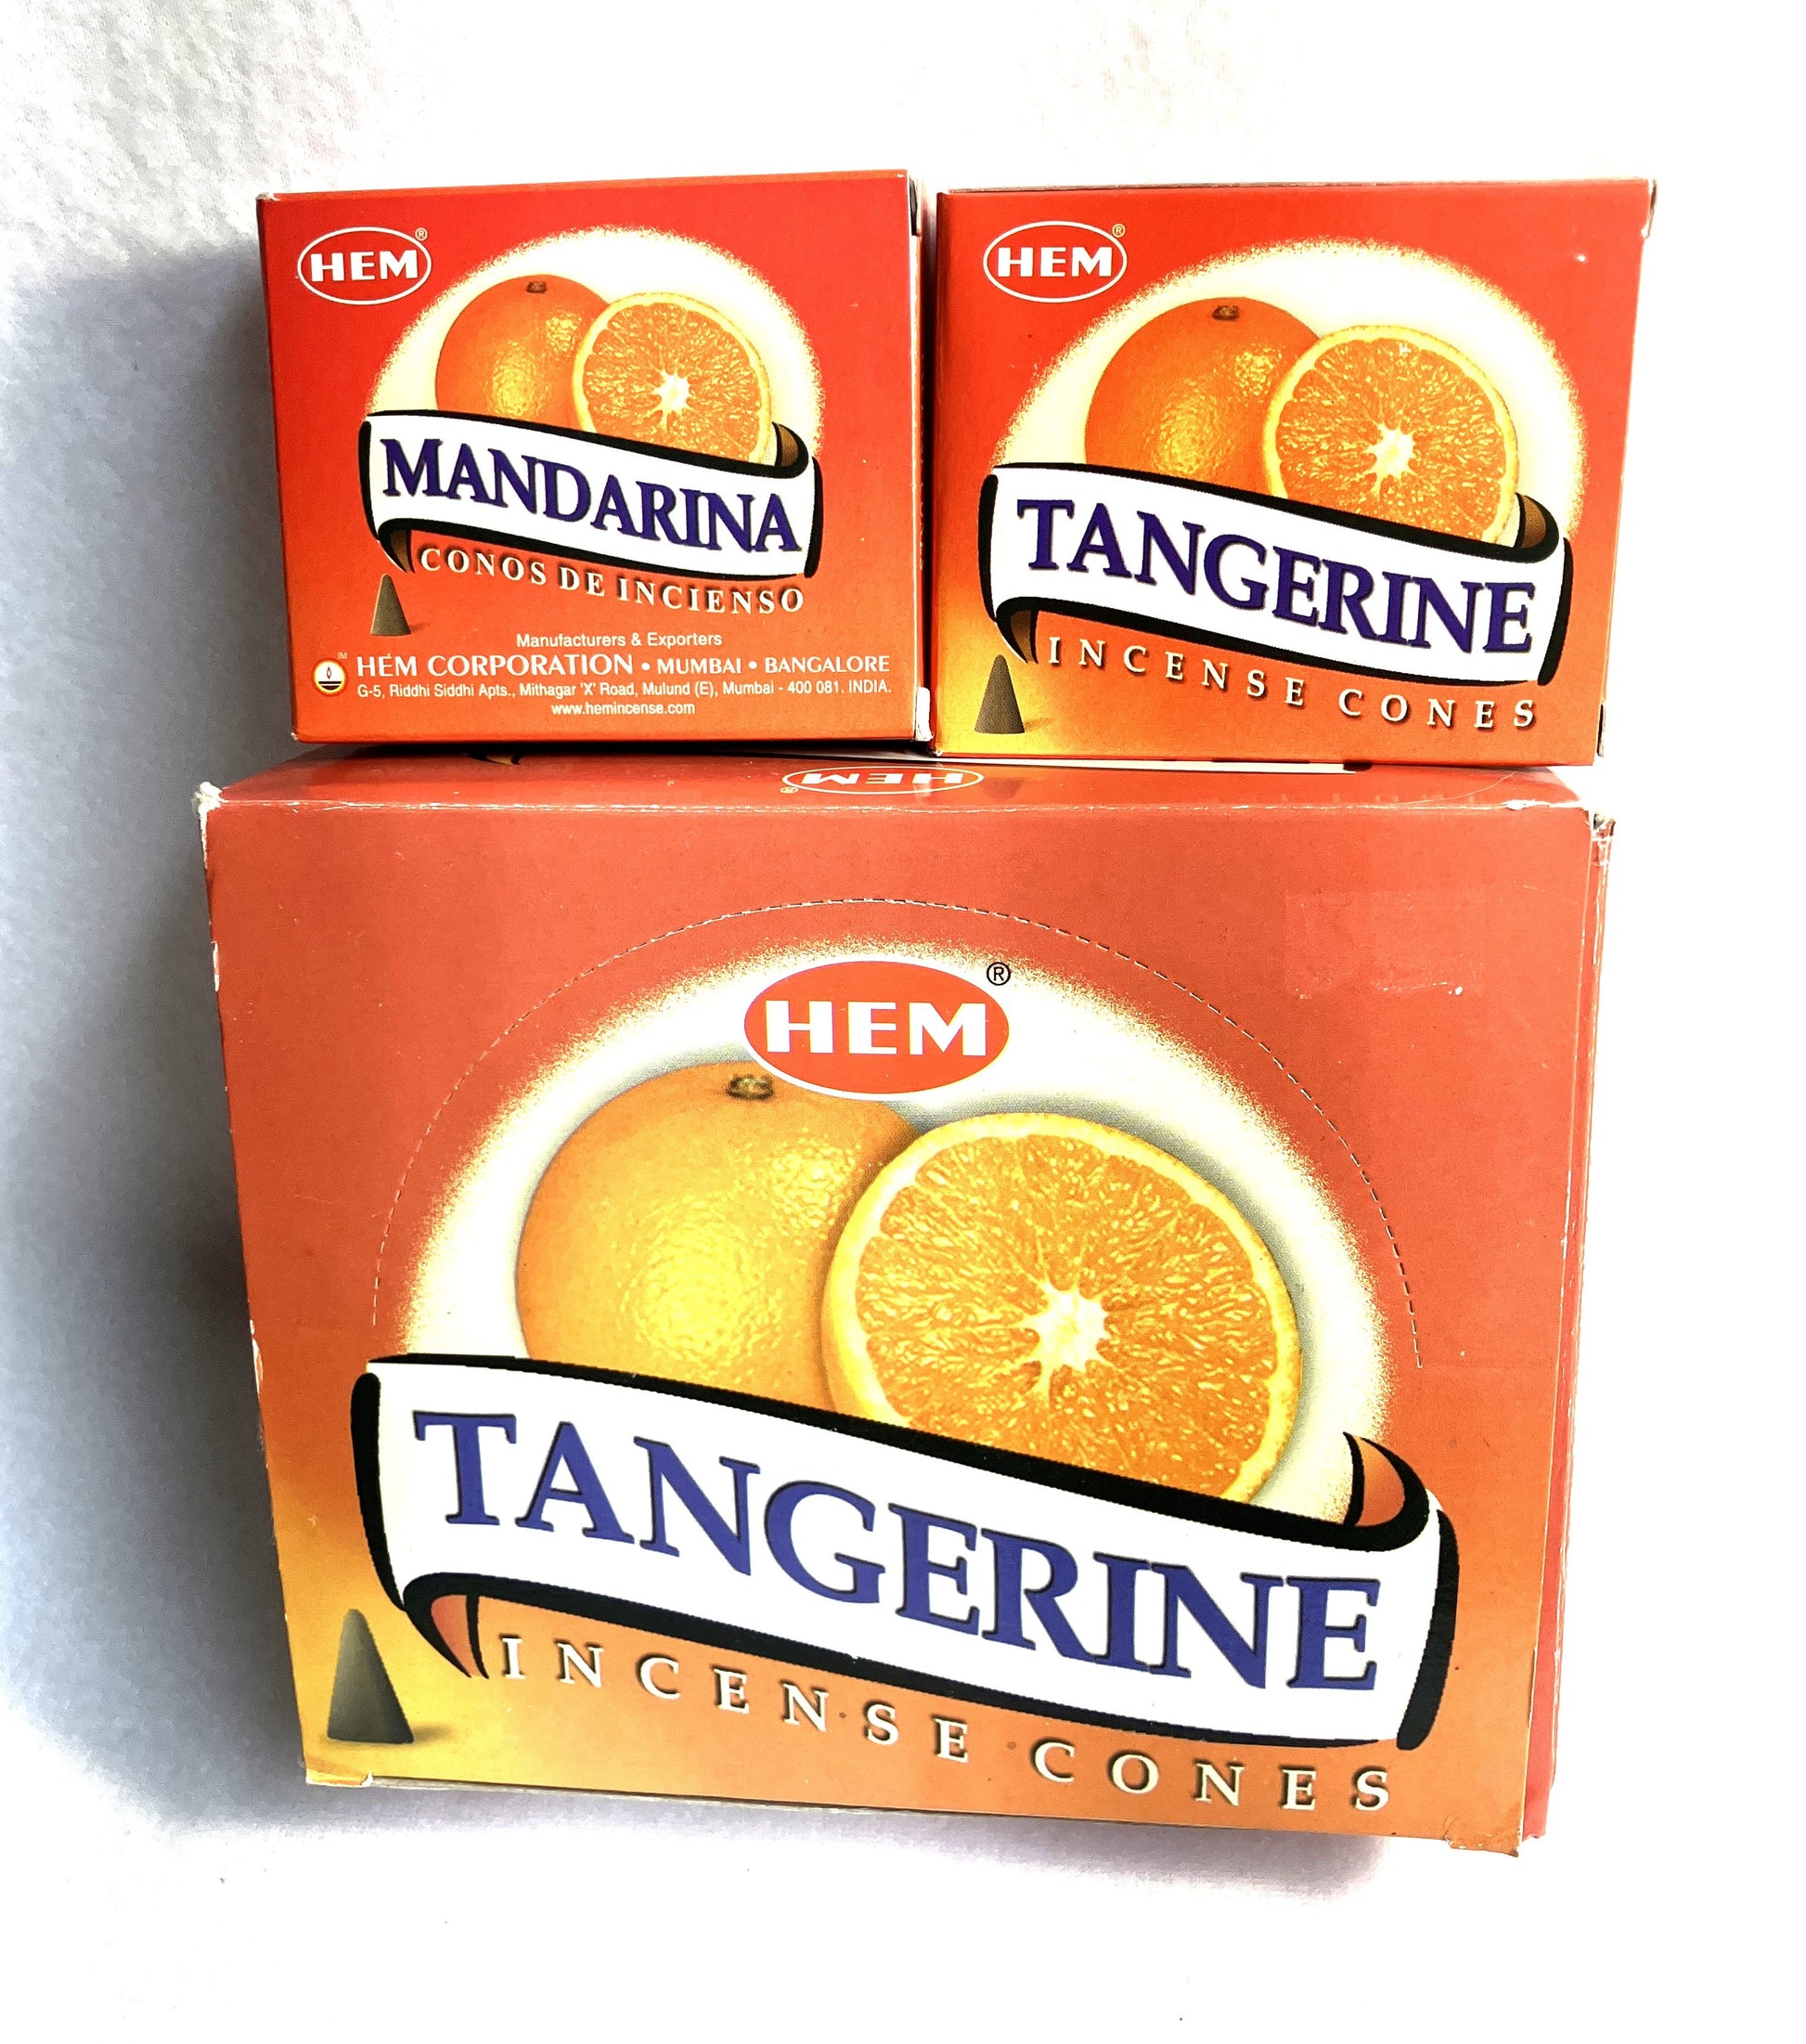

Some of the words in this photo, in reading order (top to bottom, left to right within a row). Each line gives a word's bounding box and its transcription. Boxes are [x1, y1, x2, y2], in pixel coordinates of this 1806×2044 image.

[311, 250, 418, 282] HEM
[998, 247, 1112, 278] HEM
[380, 438, 802, 553] MANDARINA
[419, 547, 548, 586] CONOS
[559, 566, 606, 598] DE
[618, 579, 805, 615] INCIENSO
[1017, 498, 1536, 654] TANGERINE
[428, 653, 634, 677] CORPORATION
[657, 657, 742, 675] MUMBAI
[764, 655, 891, 674] BANGALORE
[516, 633, 626, 648] Manufacturers
[631, 633, 642, 647] &
[648, 632, 723, 650] Exporters
[357, 683, 385, 700] G-5,
[390, 683, 431, 698] Riddhi
[434, 683, 474, 697] Siddhi
[479, 683, 516, 700] Apts.,
[520, 682, 576, 701] Mithagar
[600, 681, 639, 698] Road,
[642, 681, 690, 696] Mulund
[694, 680, 718, 698] (E),
[723, 679, 775, 695] Mumbai
[788, 679, 812, 694] 400
[848, 679, 892, 694] INDIA.
[550, 702, 696, 716] www.hemincense.com
[1048, 636, 1305, 707] INCENSE
[1338, 688, 1535, 730] CONES
[765, 999, 987, 1056] HEM
[412, 1409, 1381, 1691] TANGERINE
[498, 1635, 971, 1764] INCENSE
[1032, 1738, 1392, 1813] CONES
